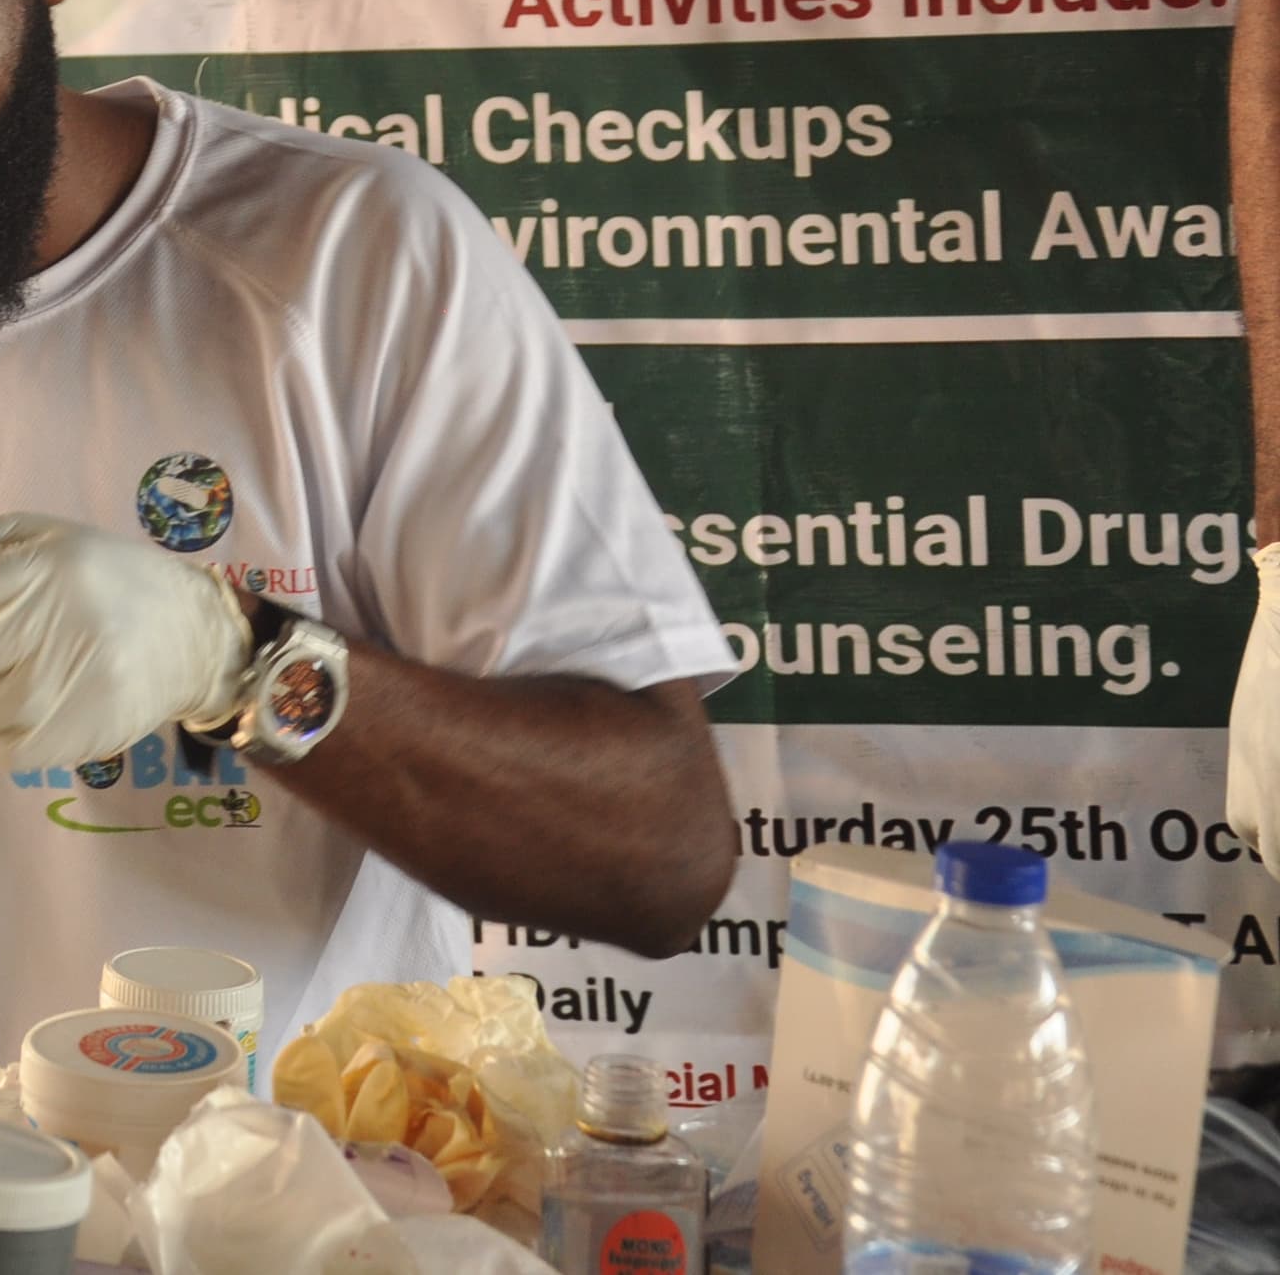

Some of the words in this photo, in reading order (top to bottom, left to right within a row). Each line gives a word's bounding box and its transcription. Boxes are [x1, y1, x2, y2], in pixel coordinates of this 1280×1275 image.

[473, 90, 894, 177] Checkups
[490, 190, 1002, 269] vironmental
[1030, 190, 1236, 261] Awa
[718, 605, 1181, 695] ounseling.
[975, 805, 1127, 862] 25th
